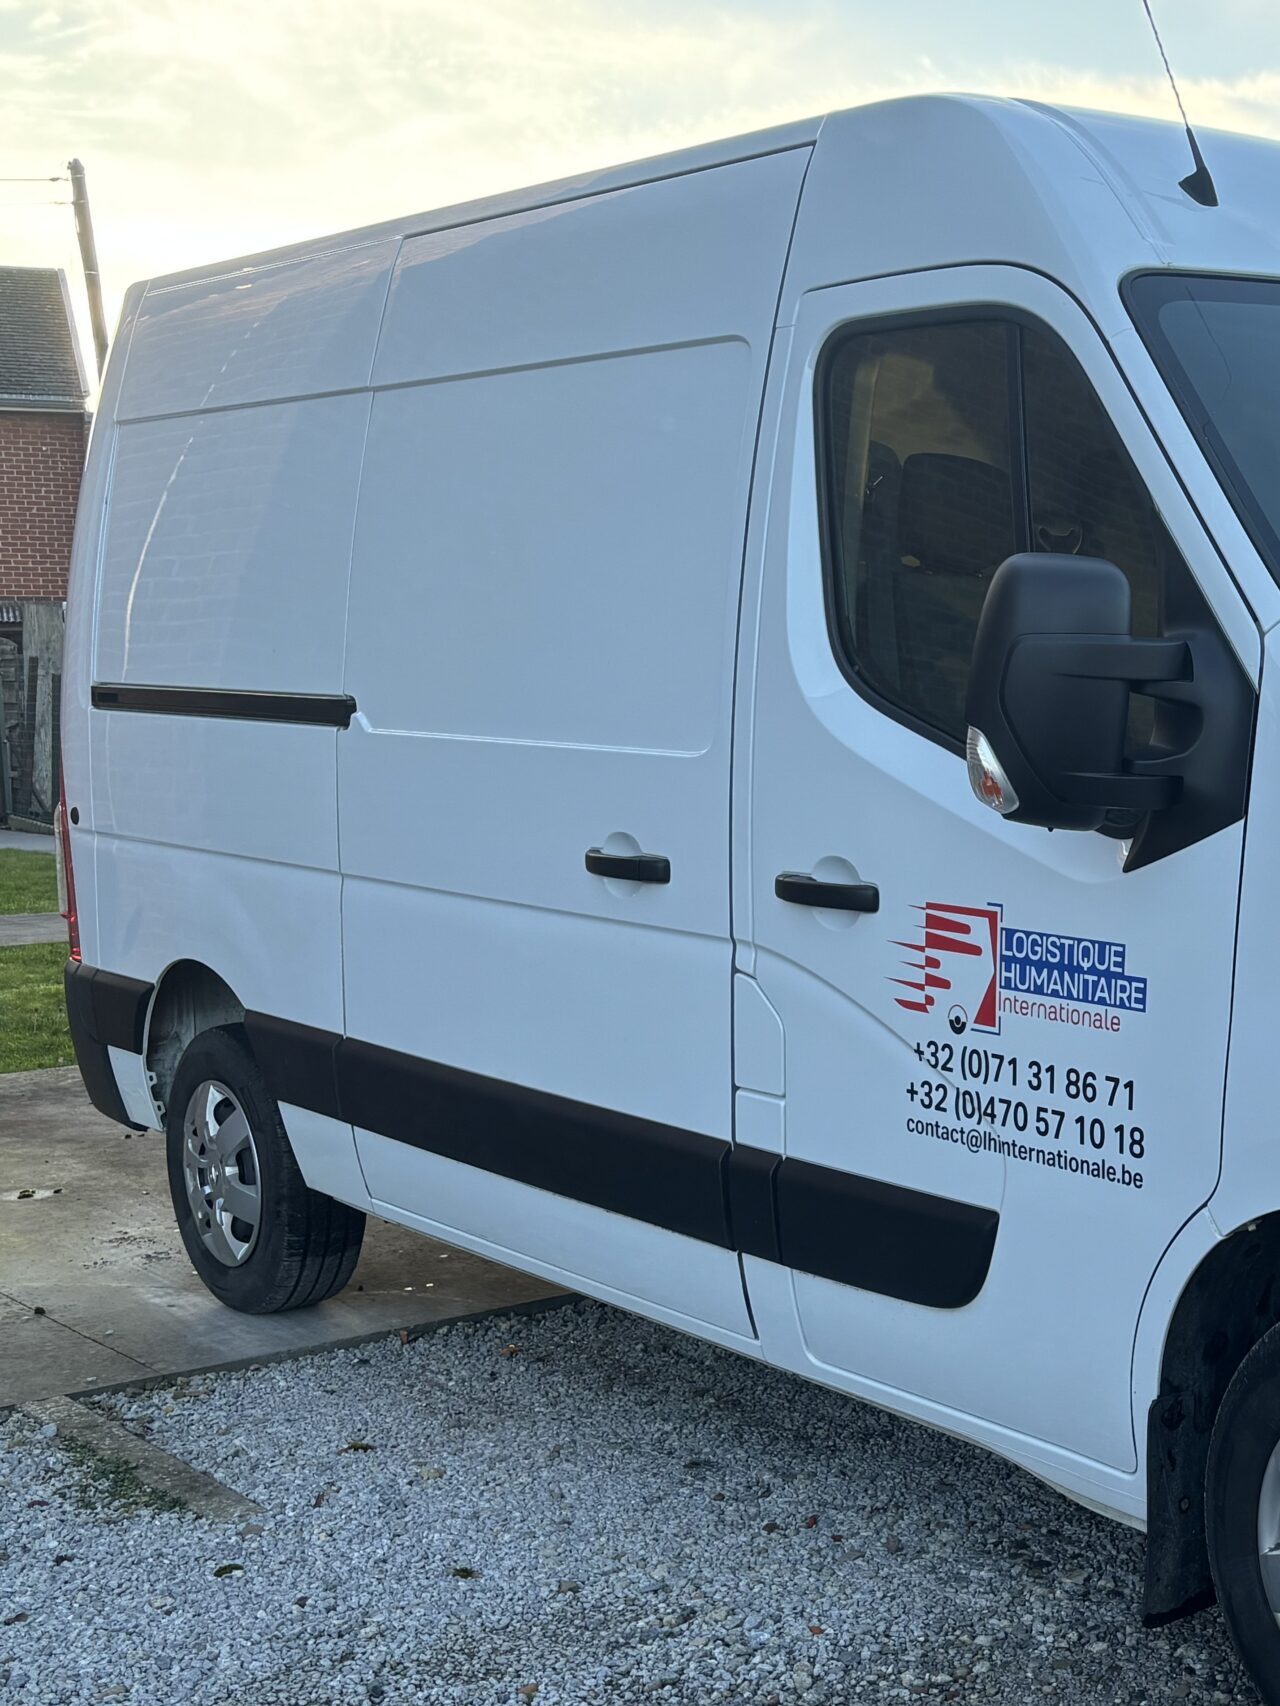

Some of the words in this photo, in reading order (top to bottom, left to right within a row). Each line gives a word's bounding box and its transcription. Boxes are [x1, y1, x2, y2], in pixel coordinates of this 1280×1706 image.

[1001, 930, 1124, 973] LOGISTIQUE
[1001, 962, 1145, 1010] HUMANITAIRE
[914, 1040, 954, 1073] +32
[961, 1045, 1018, 1086] (0)71
[1027, 1060, 1056, 1094] 31
[1065, 1068, 1098, 1103] 86
[1105, 1075, 1135, 1111] 71
[906, 1080, 948, 1113] +32
[954, 1086, 1029, 1132] (0)470
[1035, 1106, 1065, 1139] 57
[1075, 1115, 1106, 1150] 10
[1114, 1123, 1146, 1159] 18
[906, 1116, 1144, 1190] contact@lhinternationale.be
